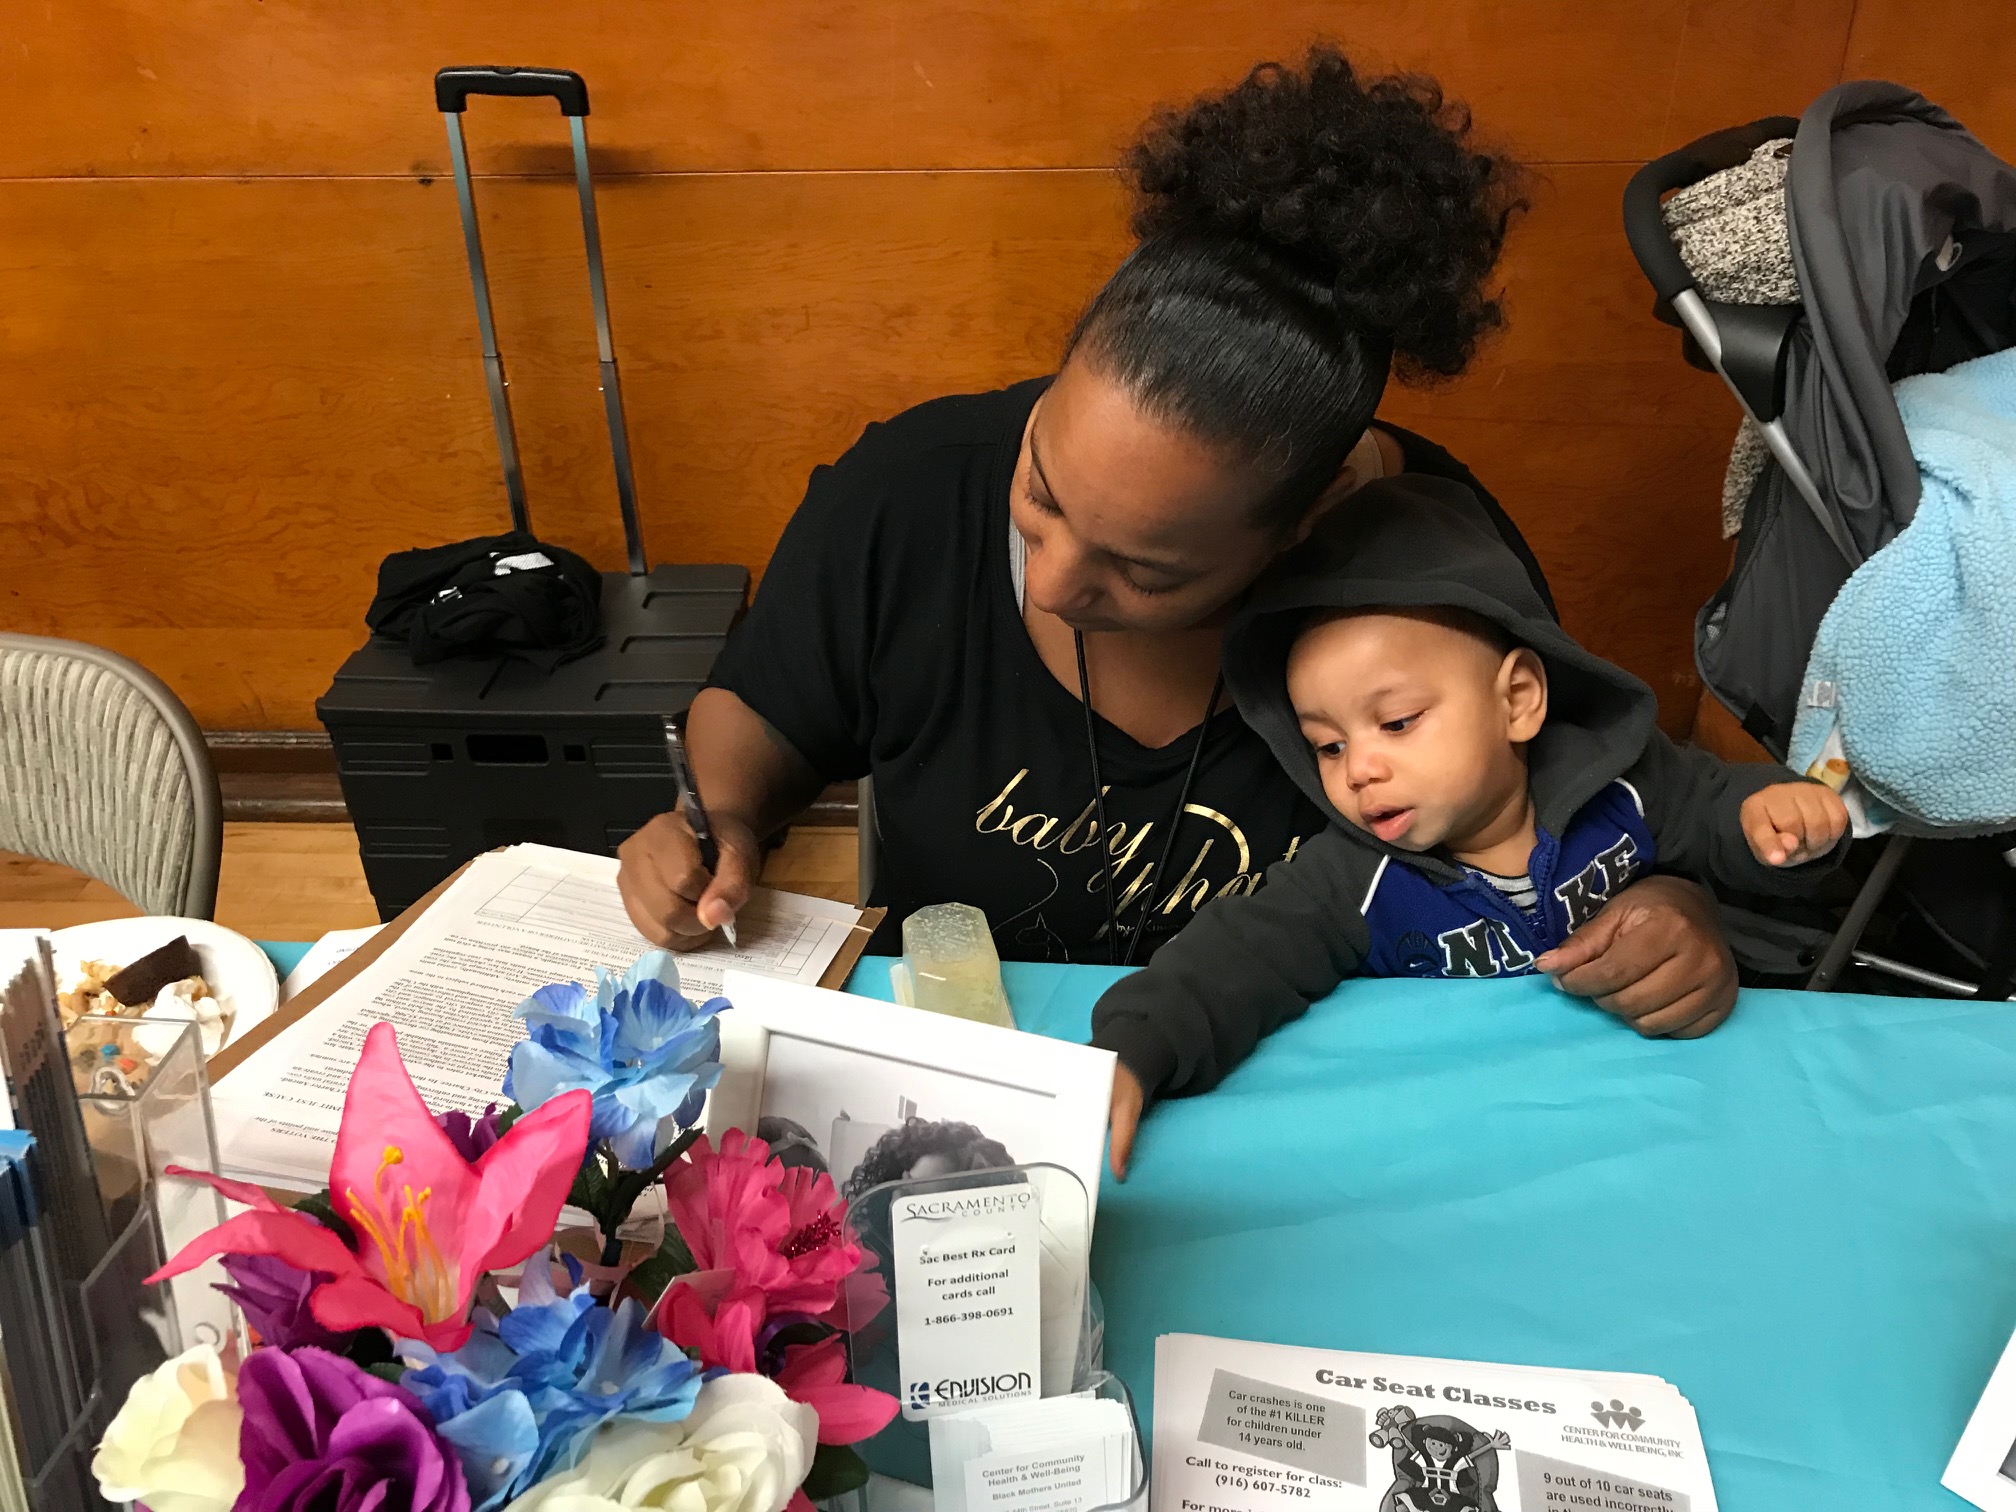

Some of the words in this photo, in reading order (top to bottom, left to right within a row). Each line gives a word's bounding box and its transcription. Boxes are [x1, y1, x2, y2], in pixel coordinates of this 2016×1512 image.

[976, 768, 1154, 893] baby
[906, 1192, 1031, 1218] SACRAMENTO
[961, 1205, 1027, 1218] COUNTY
[919, 1254, 940, 1265] Sac
[942, 1252, 968, 1262] Best
[971, 1249, 986, 1259] Rx
[989, 1245, 1016, 1256] Card
[927, 1278, 947, 1287] For
[950, 1269, 1009, 1285] additional
[942, 1289, 973, 1301] cards
[976, 1286, 996, 1296] call
[924, 1307, 1014, 1326] 1-866-398-0691
[938, 1397, 978, 1408] MEDICAL
[982, 1390, 1032, 1402] SOLUTIONS
[1228, 1390, 1247, 1401] Car
[1250, 1393, 1291, 1408] crashes
[1294, 1400, 1303, 1410] is
[1306, 1403, 1326, 1413] one
[1315, 1368, 1367, 1390] Car
[1373, 1376, 1436, 1399] Seat
[1442, 1386, 1557, 1415] Classes
[1237, 1405, 1248, 1414] of
[1250, 1406, 1267, 1417] the
[1269, 1410, 1282, 1420] #1
[1285, 1412, 1326, 1426] KILLER
[1226, 1417, 1242, 1427] for
[1244, 1419, 1289, 1434] children
[1290, 1426, 1322, 1439] under
[1563, 1425, 1598, 1438] CENTER
[1600, 1430, 1620, 1440] FOR
[1620, 1433, 1681, 1448] COMMUNITY
[1238, 1432, 1251, 1442] 14
[1253, 1435, 1283, 1447] years
[1286, 1438, 1306, 1451] old.
[1561, 1434, 1598, 1447] HEALTH
[1608, 1441, 1634, 1451] WELL
[1635, 1445, 1667, 1457] BEING,
[982, 1467, 1013, 1478] Center
[1016, 1464, 1029, 1472] for
[1032, 1454, 1085, 1470] Community
[988, 1475, 1018, 1487] Health
[1021, 1473, 1028, 1481] &
[1030, 1465, 1081, 1480] Well-Being
[1185, 1456, 1211, 1469] Call
[1215, 1460, 1228, 1471] to
[1232, 1463, 1283, 1479] register
[1286, 1471, 1305, 1482] for
[1308, 1475, 1343, 1488] class:
[993, 1493, 1016, 1501] Black
[1018, 1485, 1052, 1496] Mothers
[1054, 1478, 1082, 1490] United
[1215, 1475, 1248, 1491] (916)
[1253, 1480, 1311, 1498] 607-5782
[1544, 1472, 1551, 1483] 9
[1555, 1476, 1577, 1487] out
[1580, 1478, 1591, 1489] of
[1596, 1480, 1611, 1492] 10
[1614, 1485, 1634, 1495] car
[1638, 1487, 1673, 1501] seats
[1182, 1499, 1205, 1512] For
[1546, 1491, 1566, 1502] are
[1570, 1494, 1601, 1507] used
